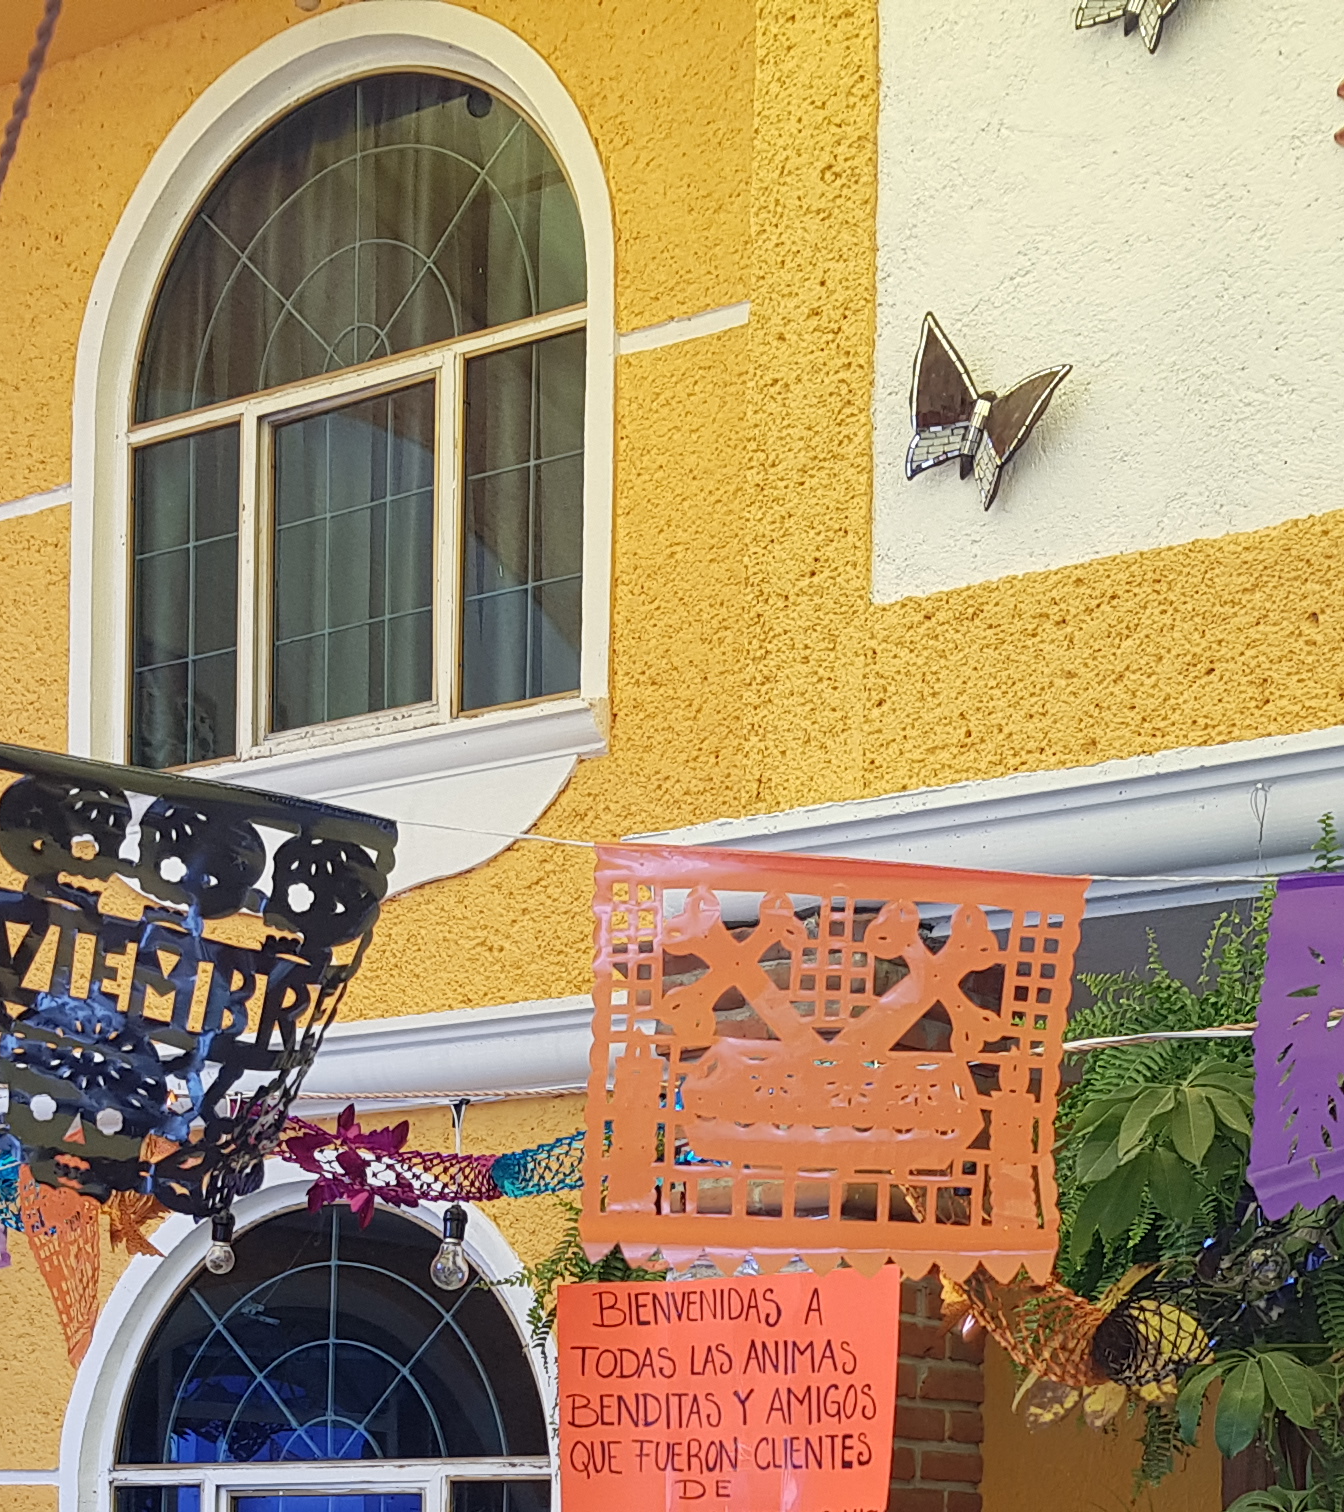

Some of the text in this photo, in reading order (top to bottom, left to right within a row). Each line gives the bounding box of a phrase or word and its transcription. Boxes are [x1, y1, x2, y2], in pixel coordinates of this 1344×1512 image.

[592, 1287, 823, 1328] BIENVENIDAS A
[570, 1338, 857, 1379] TODAS LAS ANIMAS
[566, 1382, 877, 1429] BENDITAS Y AMIGOS
[569, 1432, 873, 1480] QUE FUERON CLIENTES
[674, 1479, 732, 1500] DE
